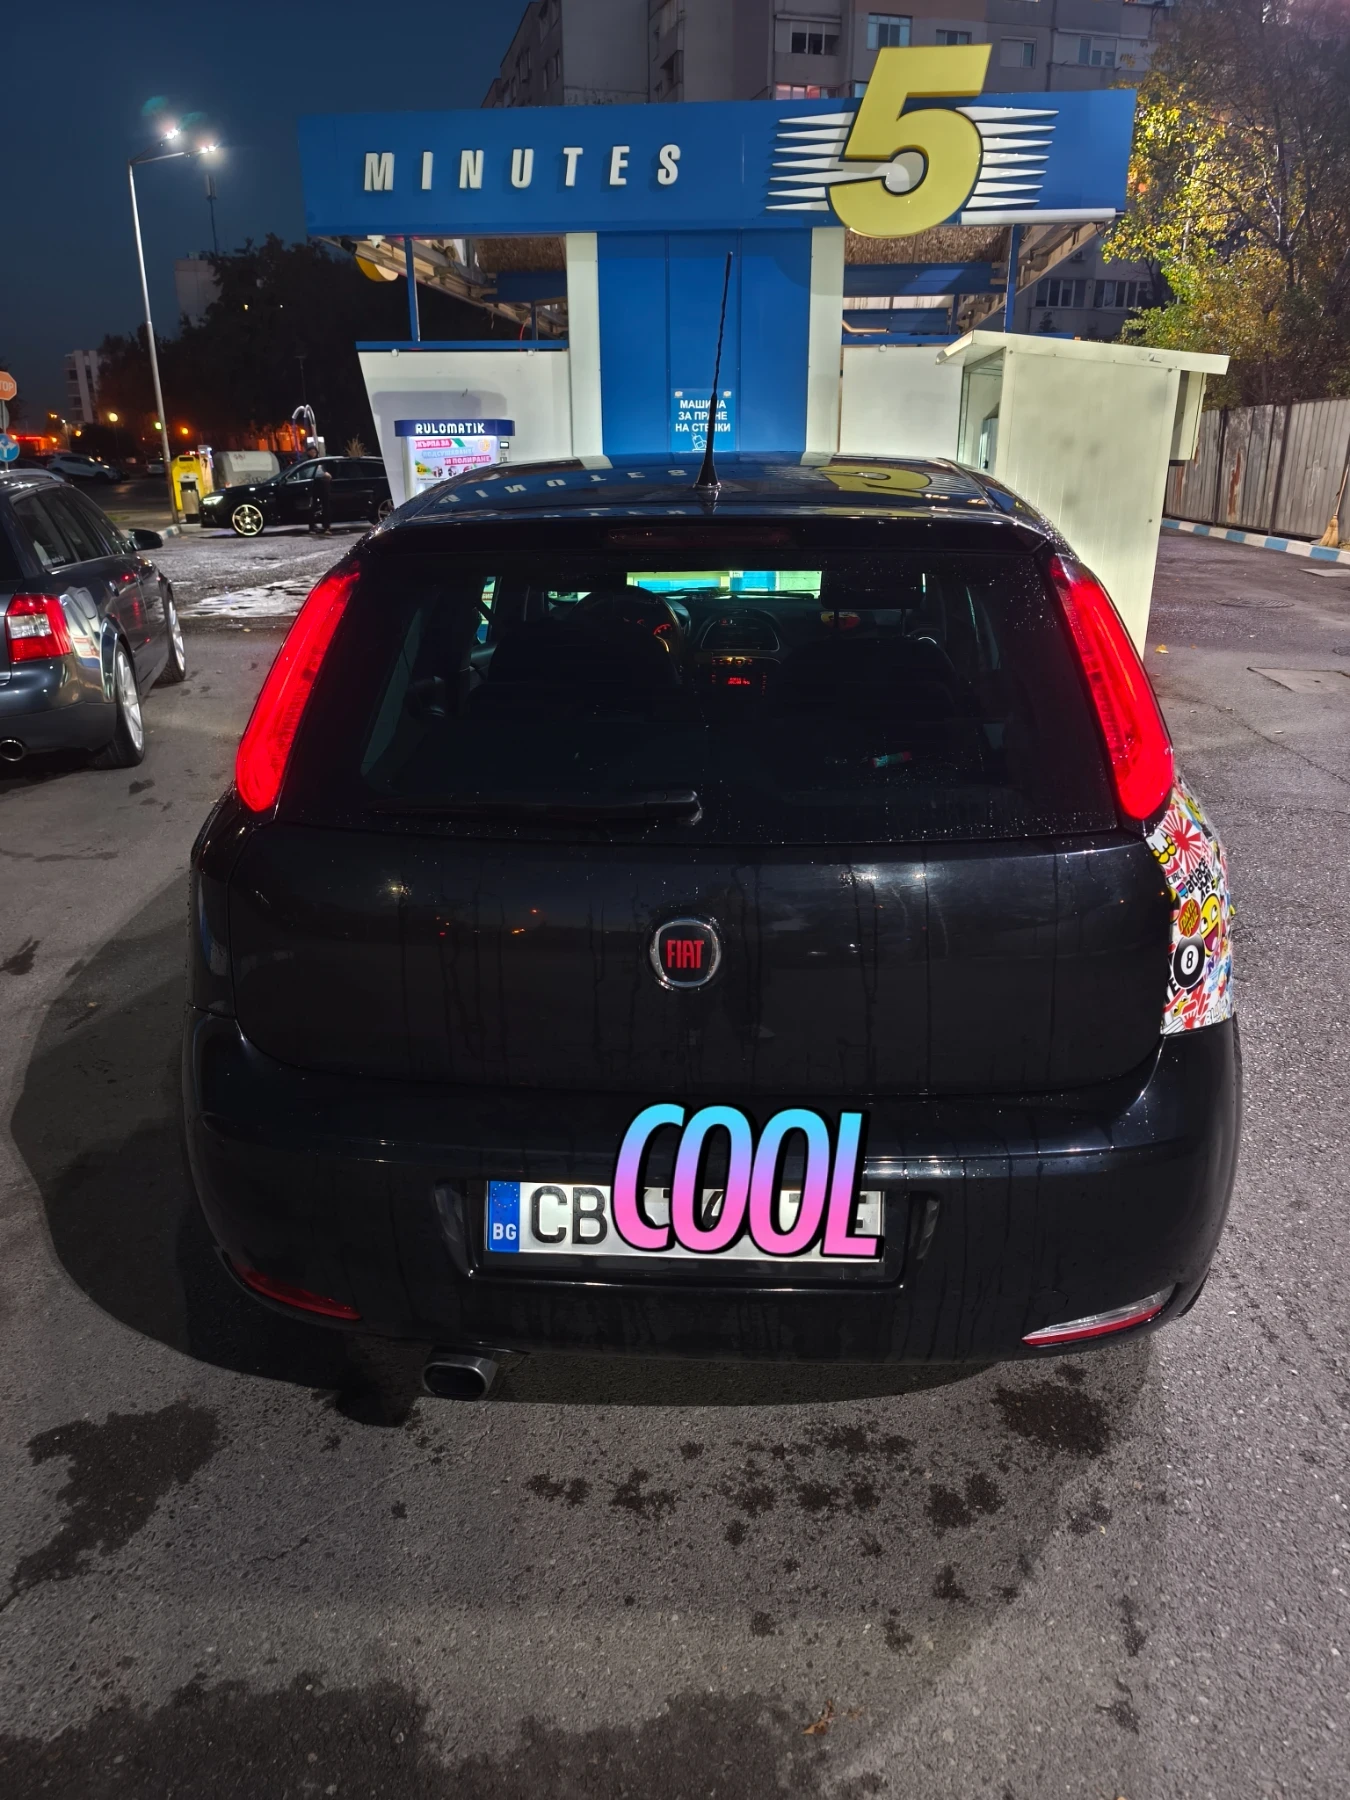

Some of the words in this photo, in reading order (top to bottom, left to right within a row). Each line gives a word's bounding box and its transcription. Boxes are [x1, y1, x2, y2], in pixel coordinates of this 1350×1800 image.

[363, 143, 681, 191] MINUTES
[828, 44, 992, 237] 5
[680, 399, 726, 409] МАШИА
[678, 411, 692, 420] ЗА
[694, 411, 728, 420] ПРНЕ
[415, 422, 485, 434] RULOMATIK
[675, 423, 689, 432] НА
[691, 423, 731, 432] СТЕКИ
[667, 939, 704, 968] FIAT
[1186, 950, 1194, 969] 8
[492, 1222, 517, 1241] BG
